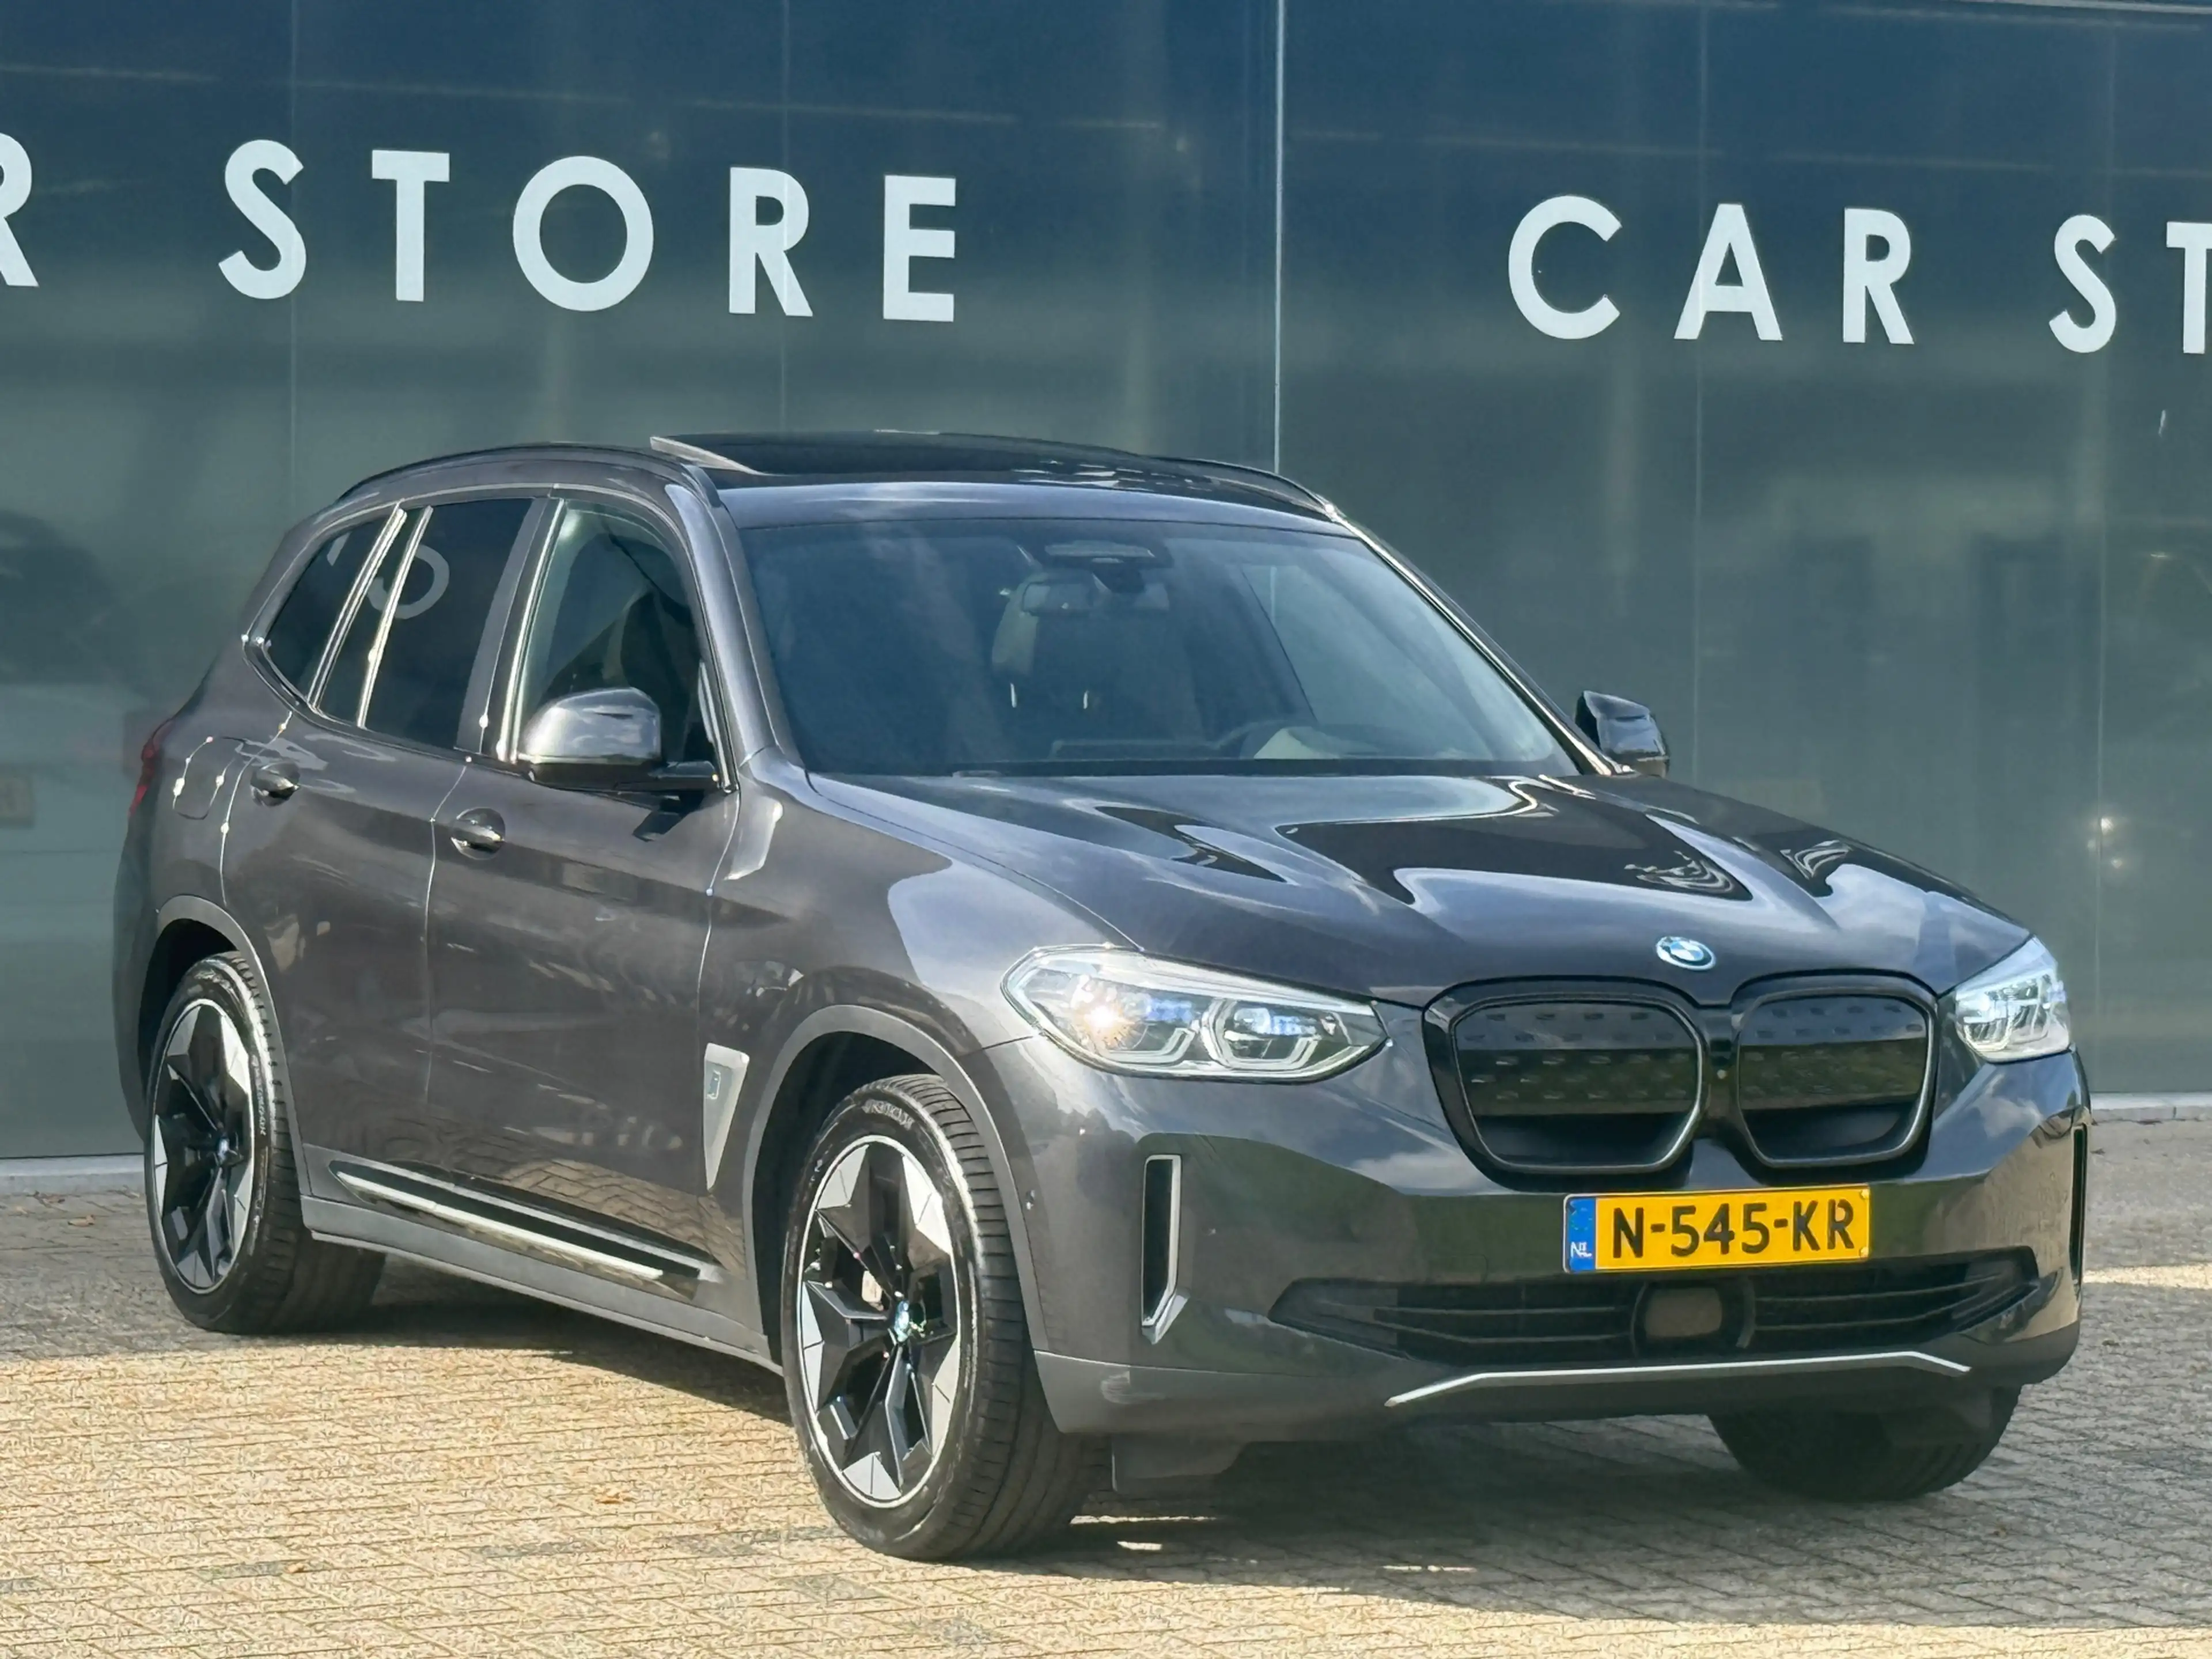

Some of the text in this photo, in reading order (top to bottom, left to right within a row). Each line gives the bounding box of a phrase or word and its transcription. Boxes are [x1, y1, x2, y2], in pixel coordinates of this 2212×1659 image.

[218, 140, 955, 322] STORE
[1509, 196, 1914, 344] CAR
[1570, 1199, 1854, 1259] NL N-545-KR
